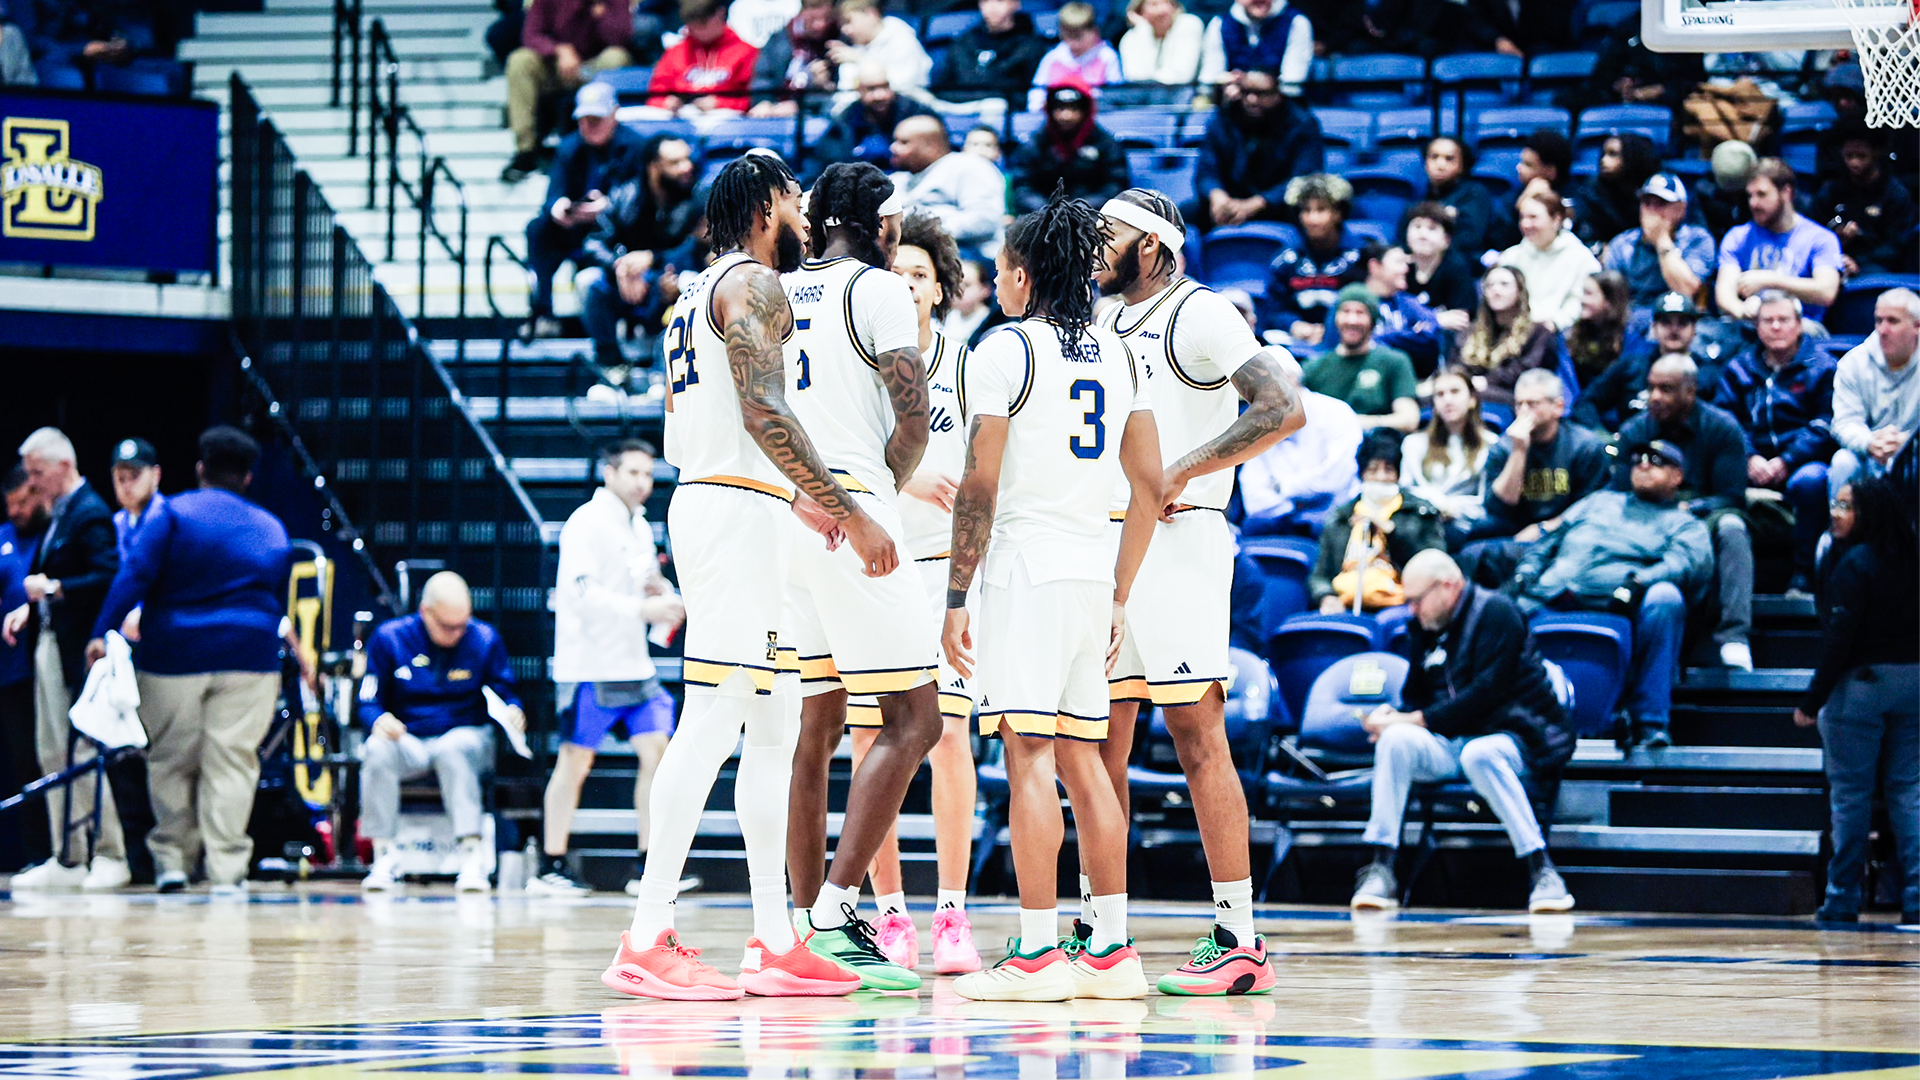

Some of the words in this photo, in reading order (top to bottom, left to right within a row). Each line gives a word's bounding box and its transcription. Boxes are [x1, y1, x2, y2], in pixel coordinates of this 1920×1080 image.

[1681, 13, 1735, 27] SPALDING
[792, 284, 825, 304] HARRIS
[669, 307, 701, 395] 24
[1069, 378, 1106, 460] 3
[762, 427, 851, 520] Camden
